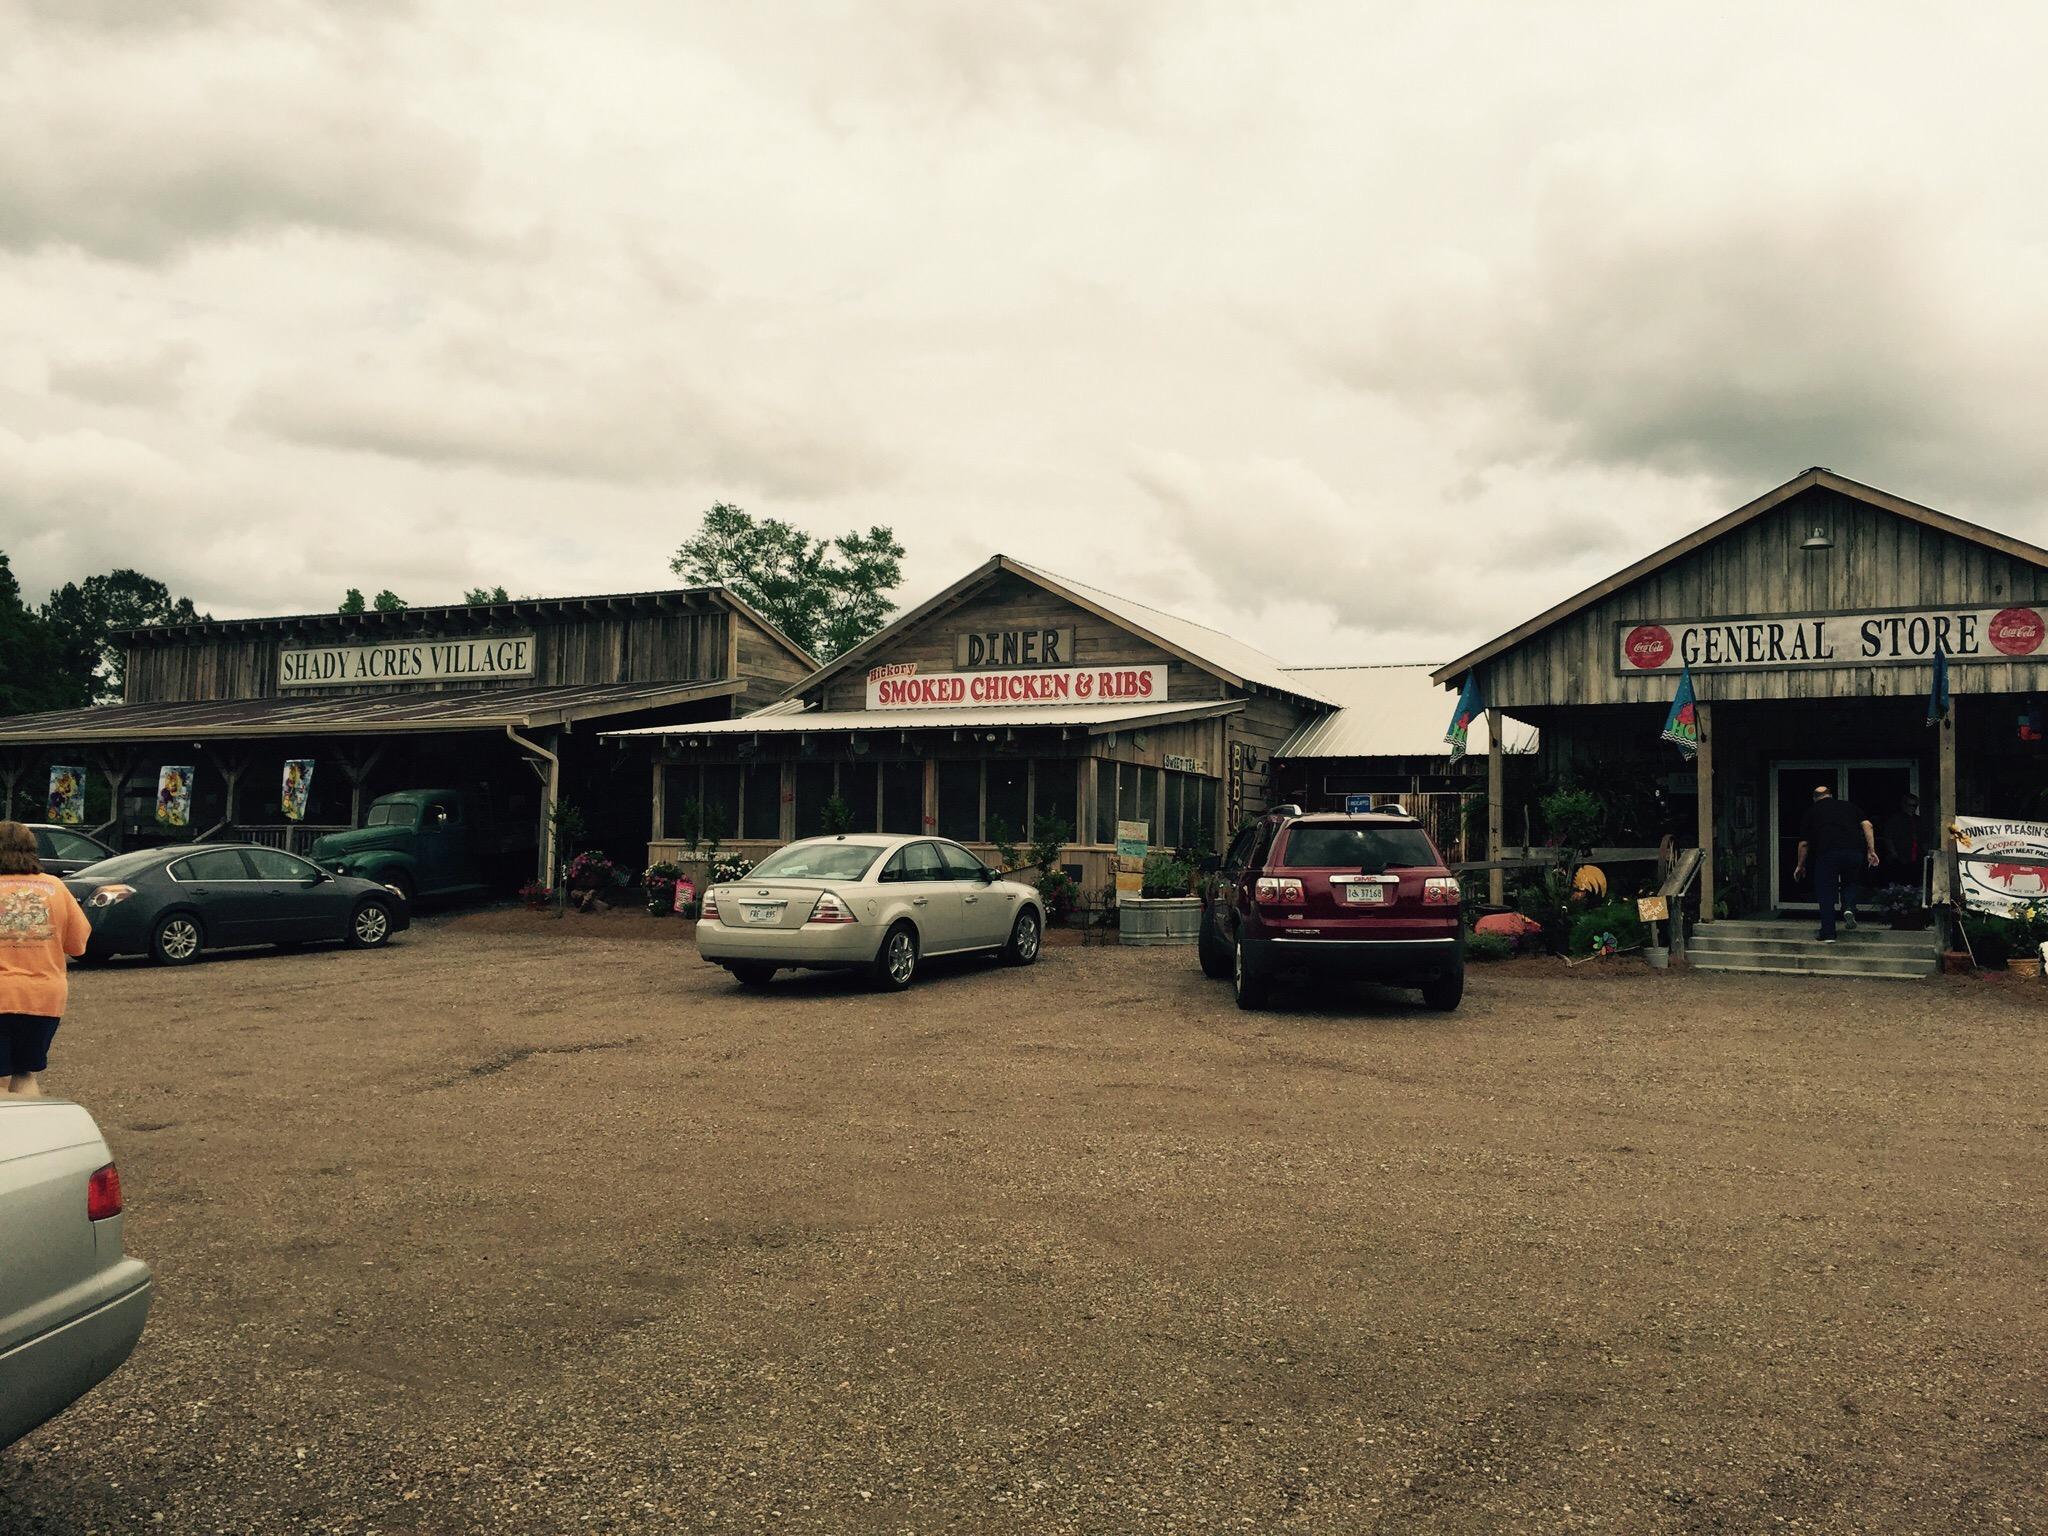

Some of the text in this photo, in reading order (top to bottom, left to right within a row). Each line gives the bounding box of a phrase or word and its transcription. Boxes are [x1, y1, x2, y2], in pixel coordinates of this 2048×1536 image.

[968, 630, 1061, 666] DINER
[1681, 614, 1979, 665] GENERAL STORE
[283, 641, 527, 681] SHADY ACRES VILLAGE
[869, 663, 916, 681] Hickory
[879, 670, 1153, 705] SMOKED CHICKEN & RIBS
[1232, 744, 1241, 833] BBQ
[2015, 847, 2033, 855] MEAT
